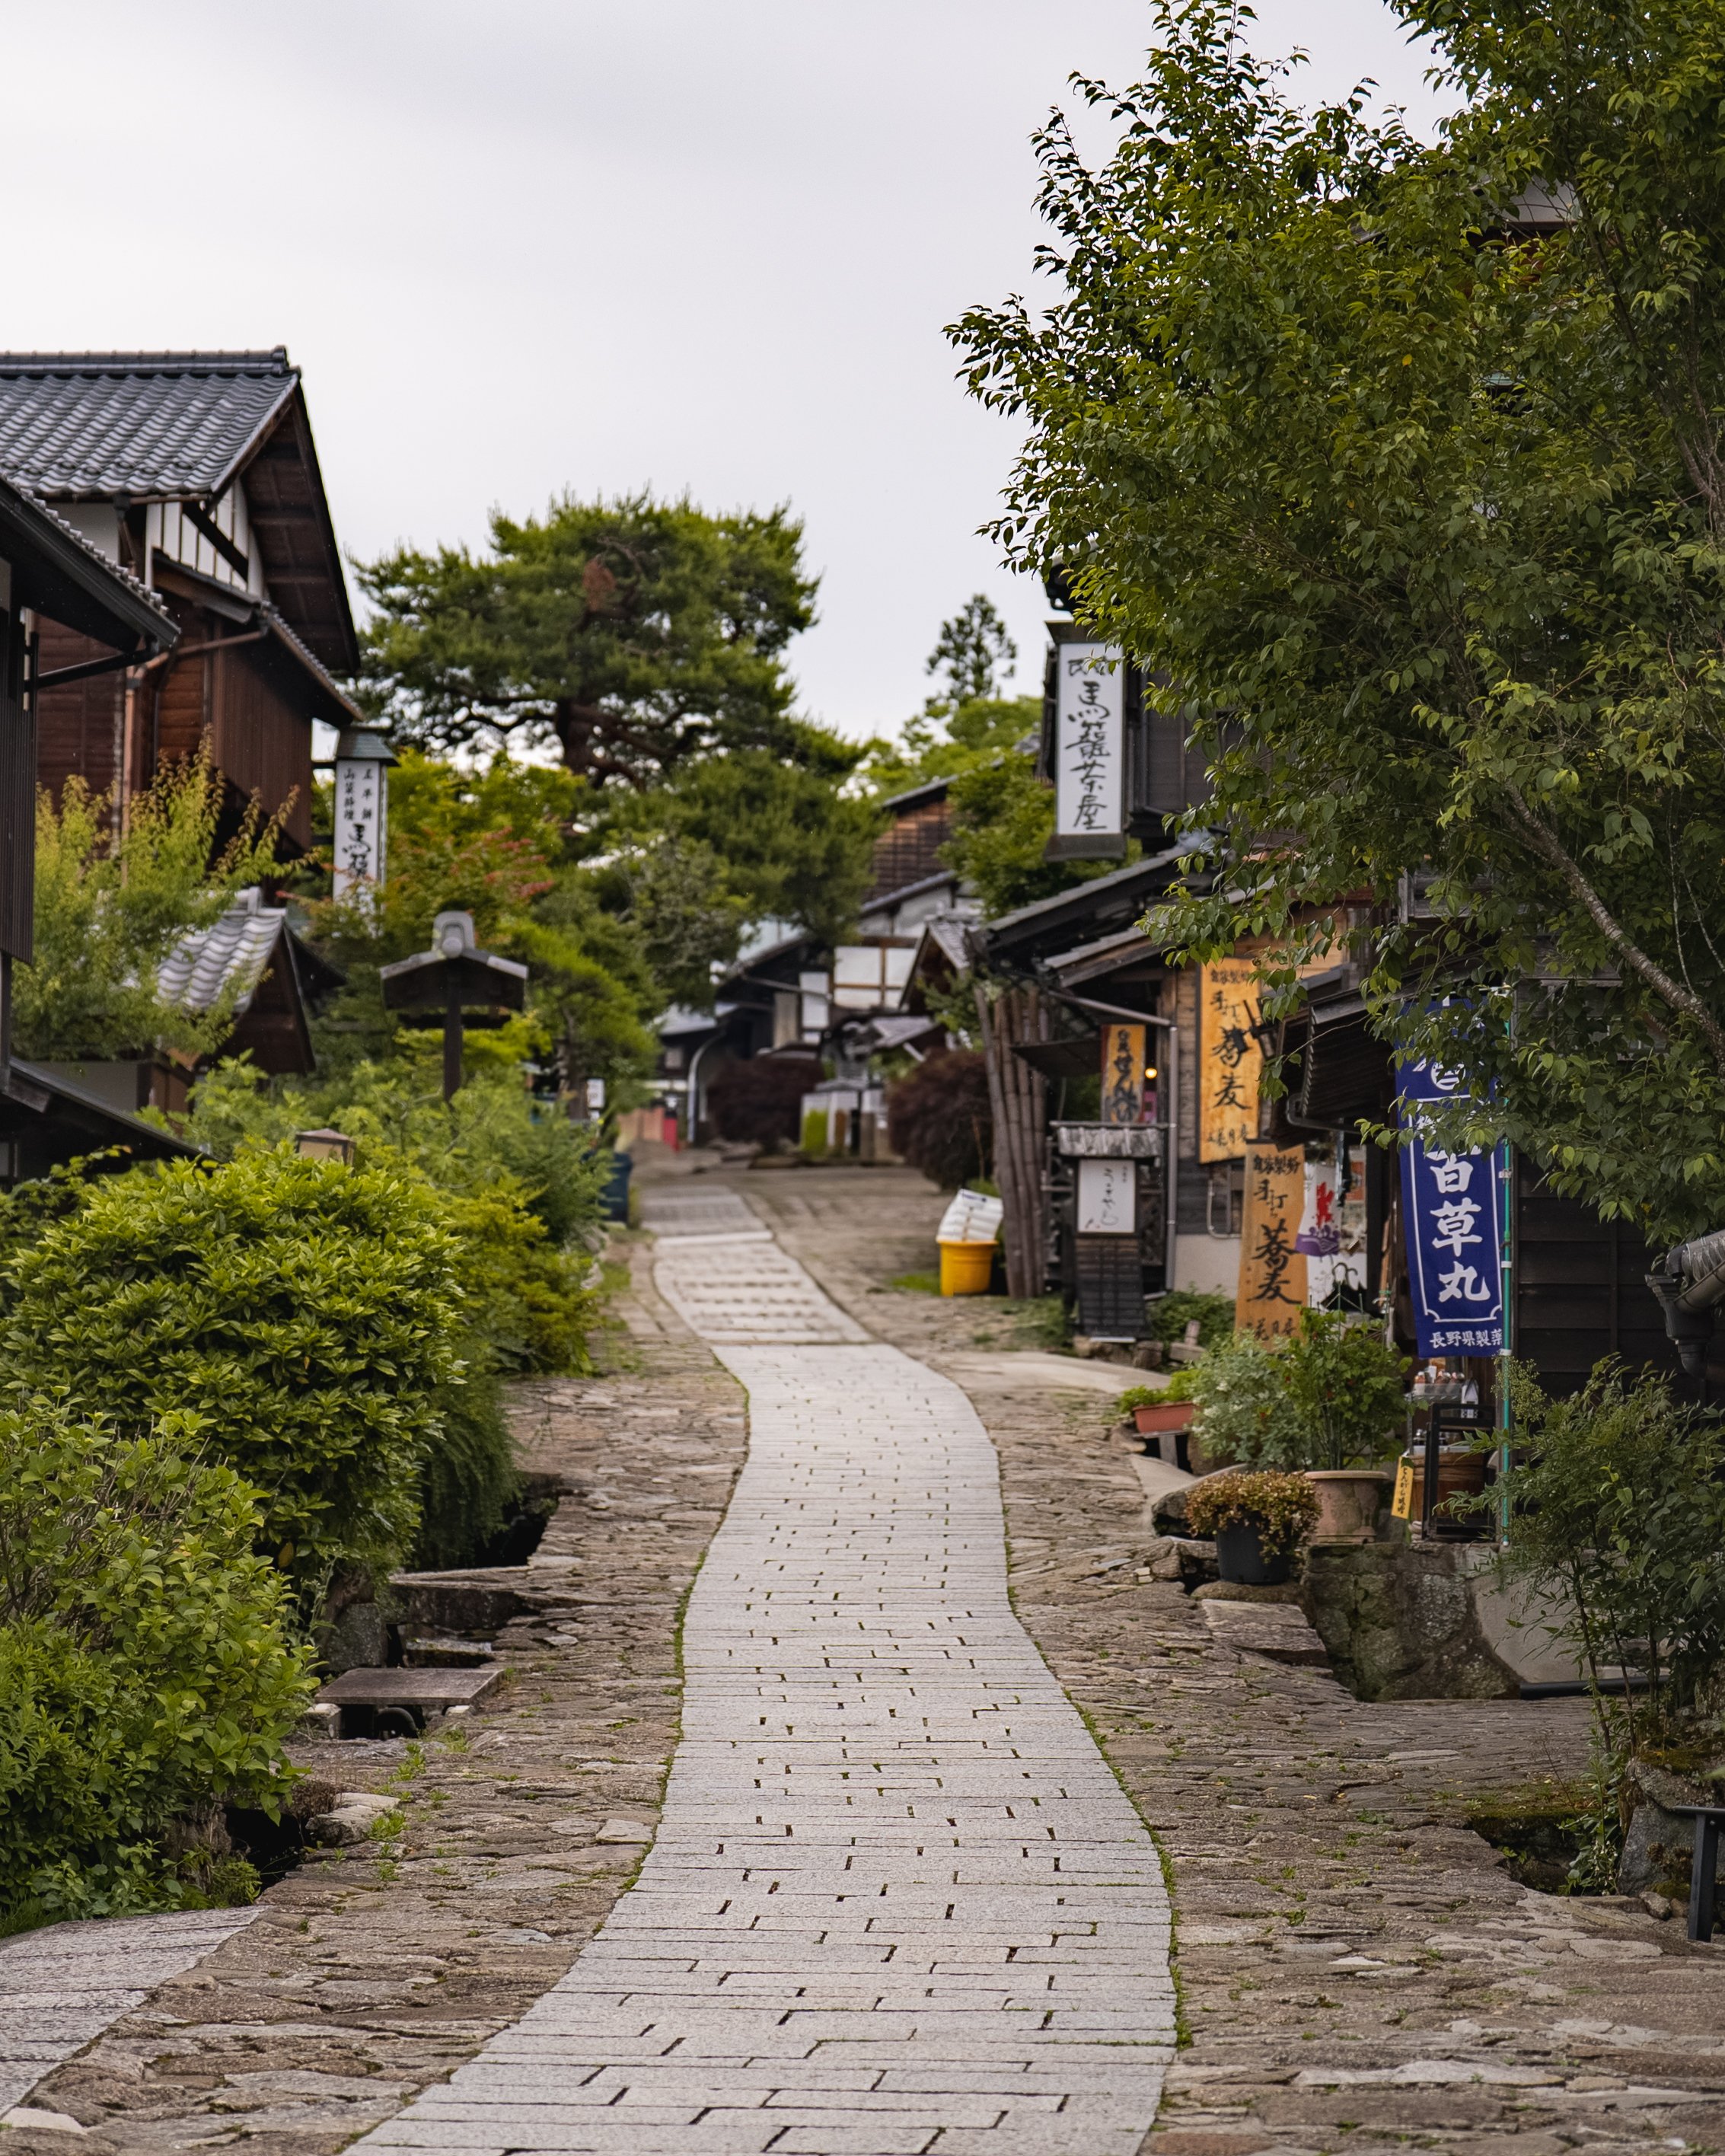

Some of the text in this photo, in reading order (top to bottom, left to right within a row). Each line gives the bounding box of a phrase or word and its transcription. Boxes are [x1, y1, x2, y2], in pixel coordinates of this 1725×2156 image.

[1066, 681, 1111, 830] 馬籠茶屋
[1429, 1328, 1503, 1348] 長野県製薬
